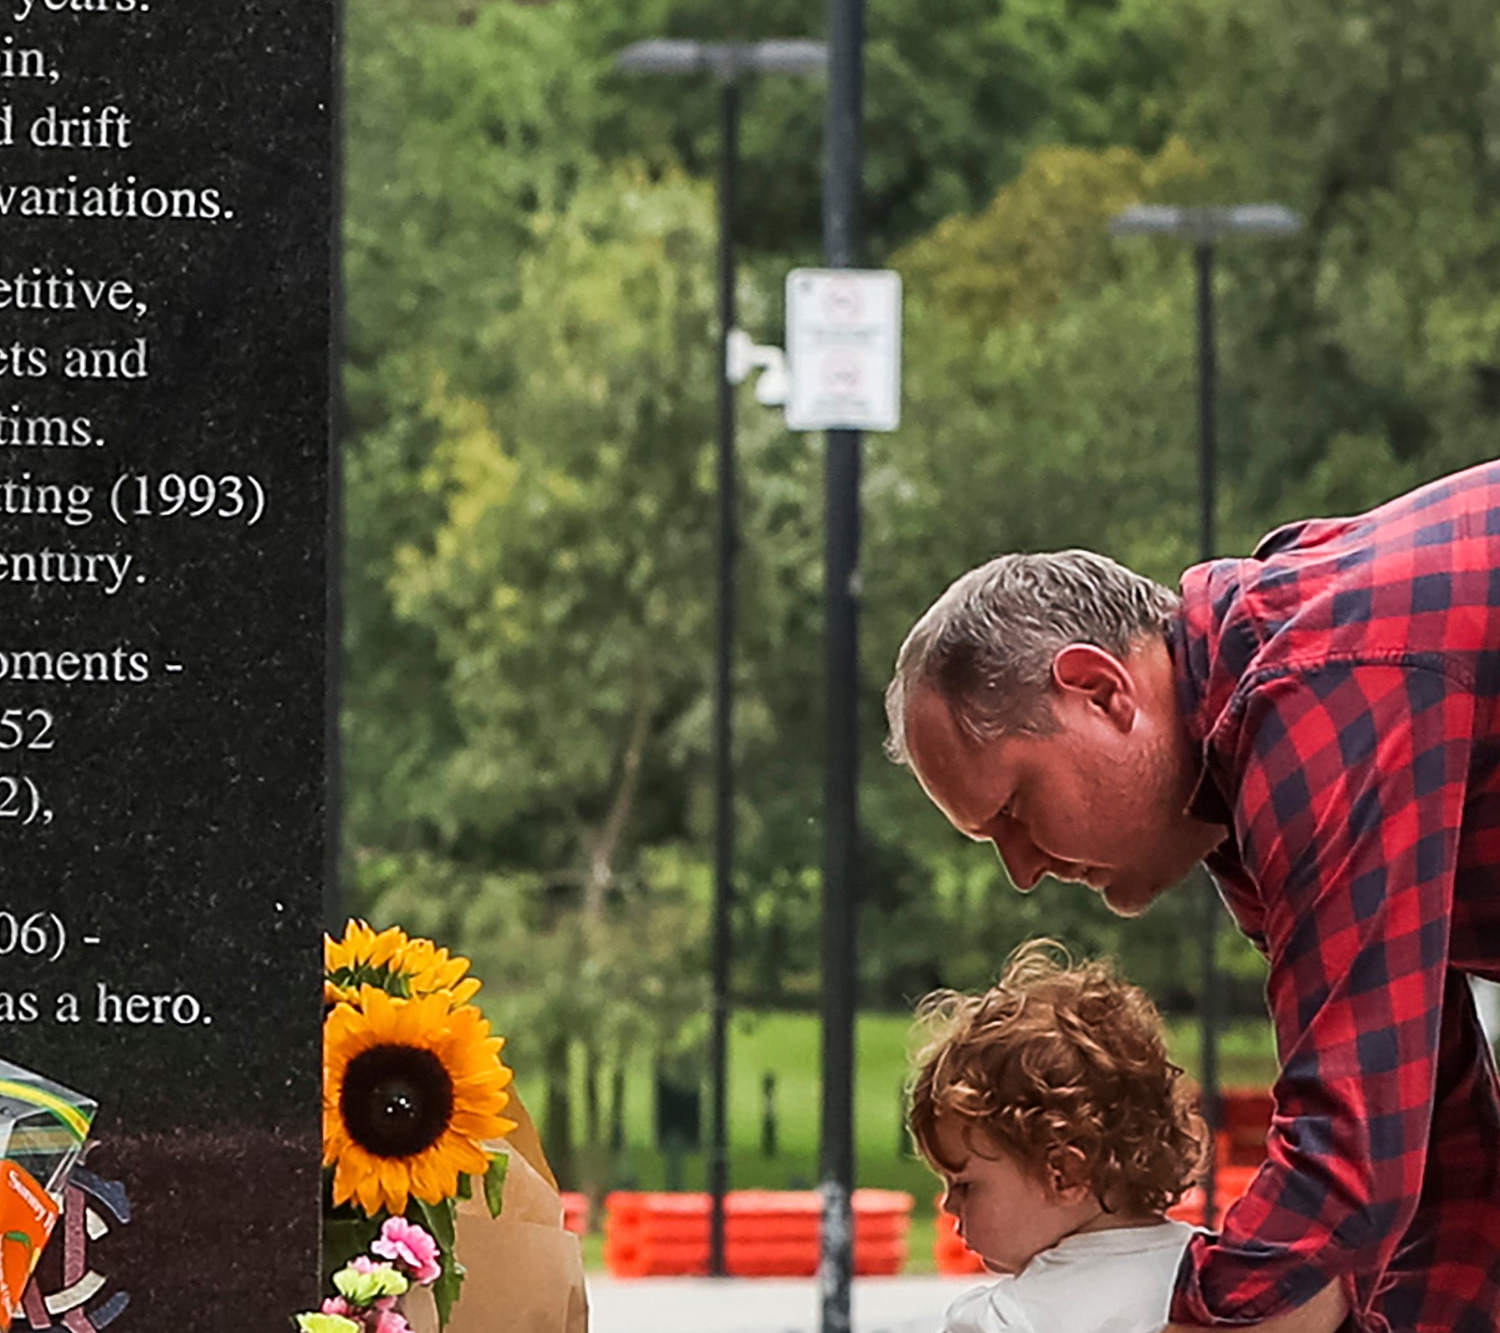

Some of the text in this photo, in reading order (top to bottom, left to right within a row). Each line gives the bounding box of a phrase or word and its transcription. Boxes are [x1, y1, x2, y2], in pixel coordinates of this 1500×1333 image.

[29, 105, 132, 149] drift
[63, 337, 148, 379] and
[110, 472, 265, 526] (1993)
[55, 992, 81, 1023] a
[96, 982, 212, 1025] hero.
